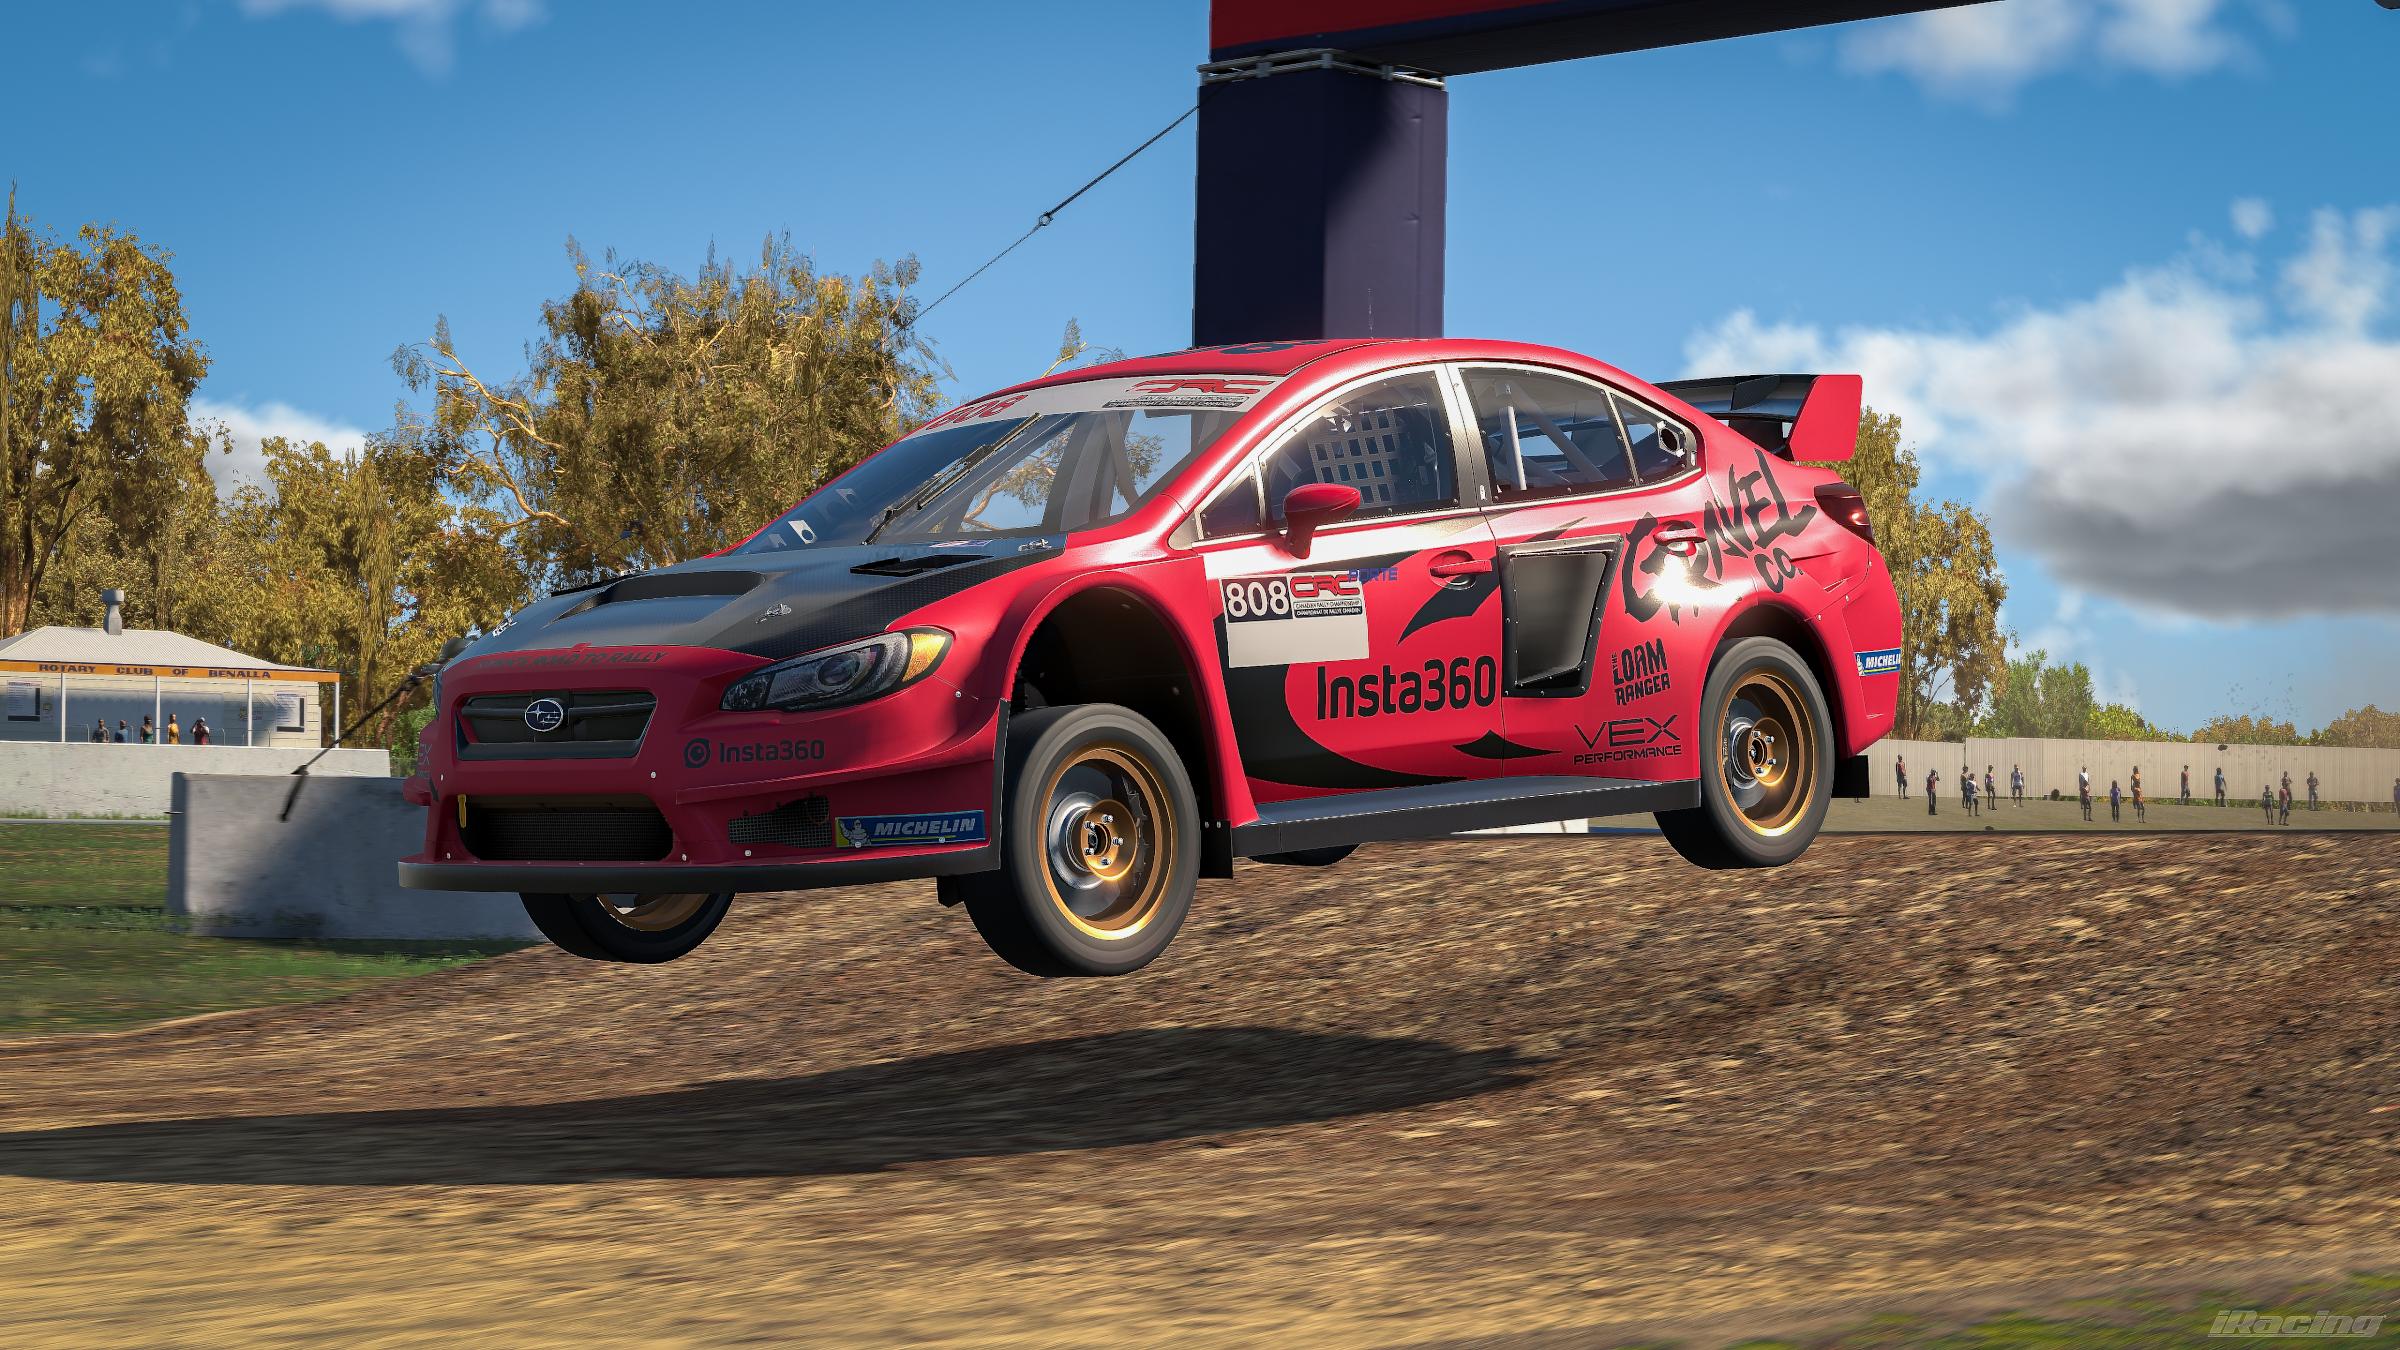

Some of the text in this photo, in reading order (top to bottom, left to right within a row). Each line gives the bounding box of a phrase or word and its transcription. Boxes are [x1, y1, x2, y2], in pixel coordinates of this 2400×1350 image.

[1226, 580, 1290, 618] 808
[1290, 574, 1361, 599] CRC
[38, 664, 272, 679] ROTARY CLUB OF BENALLA
[1613, 638, 1668, 686] LOAM
[1317, 655, 1497, 721] Insta360
[1615, 673, 1671, 706] RANGER
[1574, 714, 1681, 750] VEX
[719, 739, 826, 763] Insta360
[1573, 744, 1682, 766] PERFORMANCE
[874, 817, 977, 838] MICHELIN
